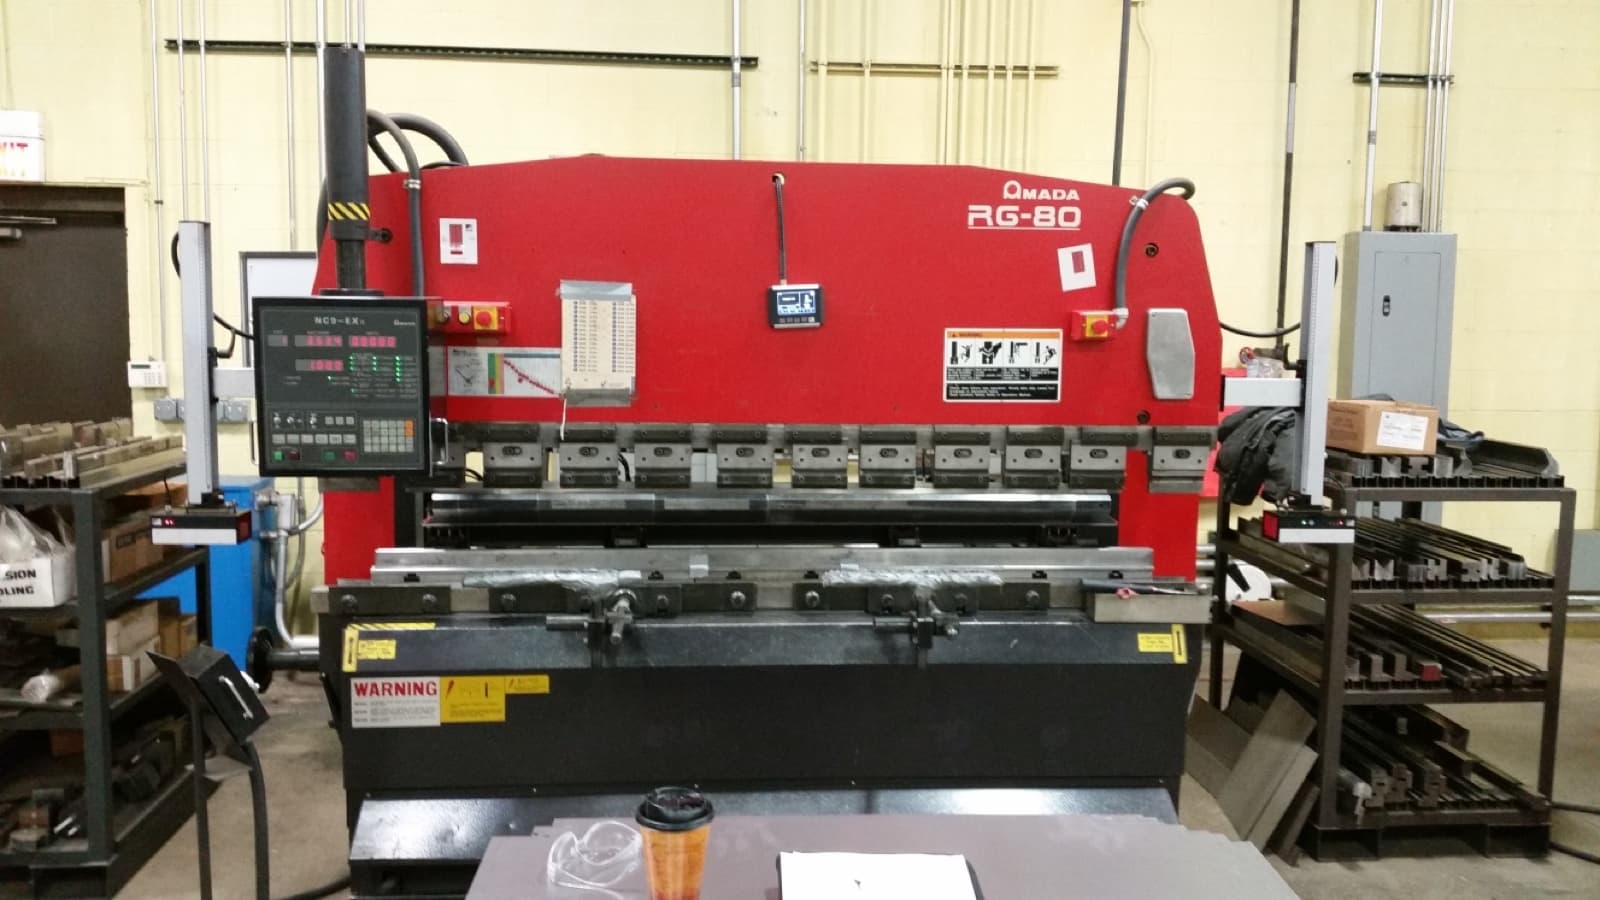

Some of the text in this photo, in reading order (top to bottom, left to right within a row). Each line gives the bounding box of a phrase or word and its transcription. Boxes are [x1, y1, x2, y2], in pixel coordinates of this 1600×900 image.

[1003, 180, 1080, 200] AMADA
[968, 205, 1081, 227] RG-80
[354, 681, 437, 697] WARNING
